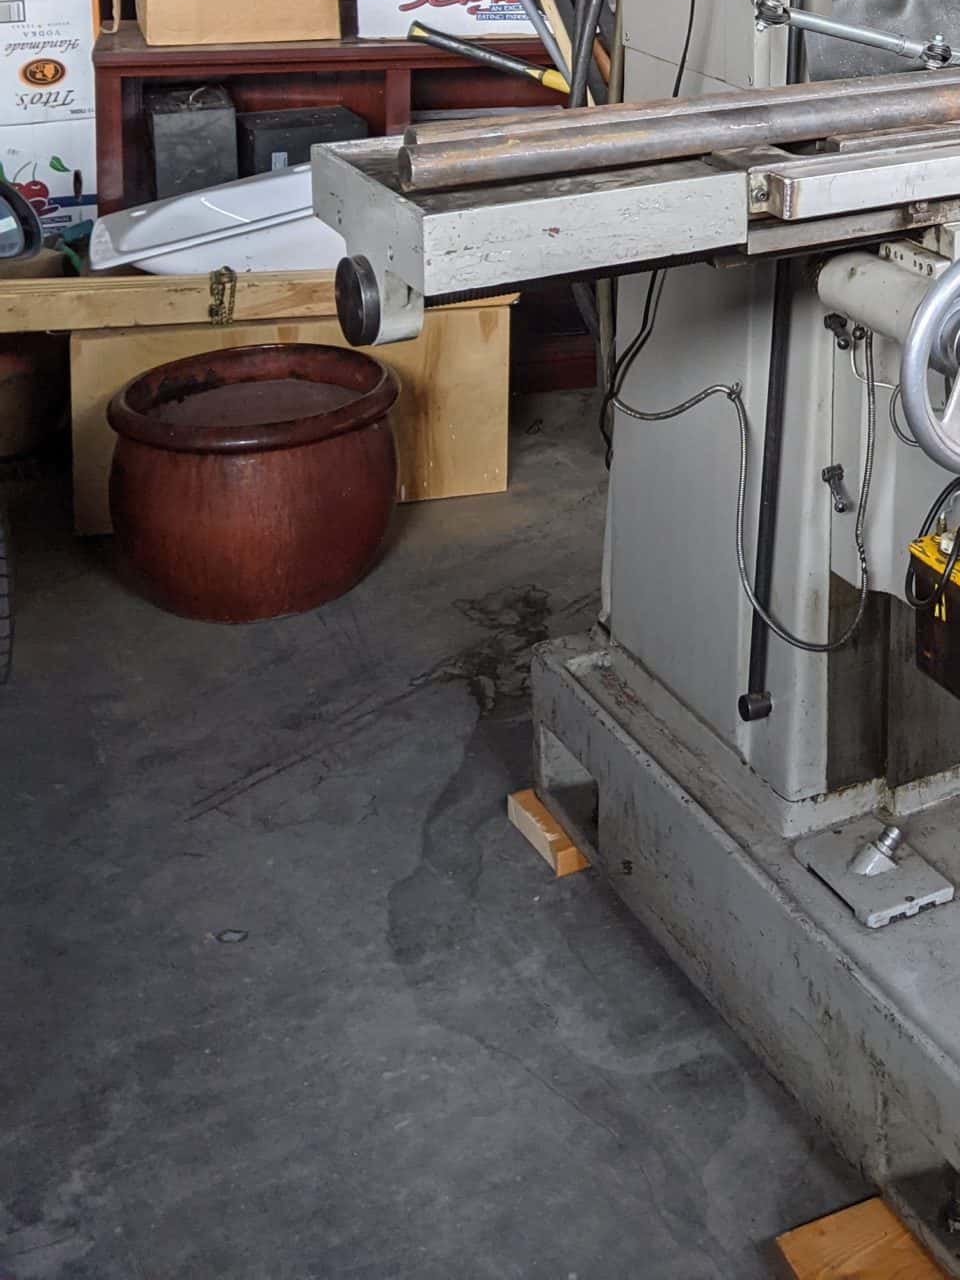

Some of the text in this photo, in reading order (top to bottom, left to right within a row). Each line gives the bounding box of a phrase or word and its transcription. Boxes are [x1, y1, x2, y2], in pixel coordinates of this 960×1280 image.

[23, 30, 62, 38] VODKA
[5, 38, 80, 56] Handmade
[15, 89, 75, 110] Tito's
